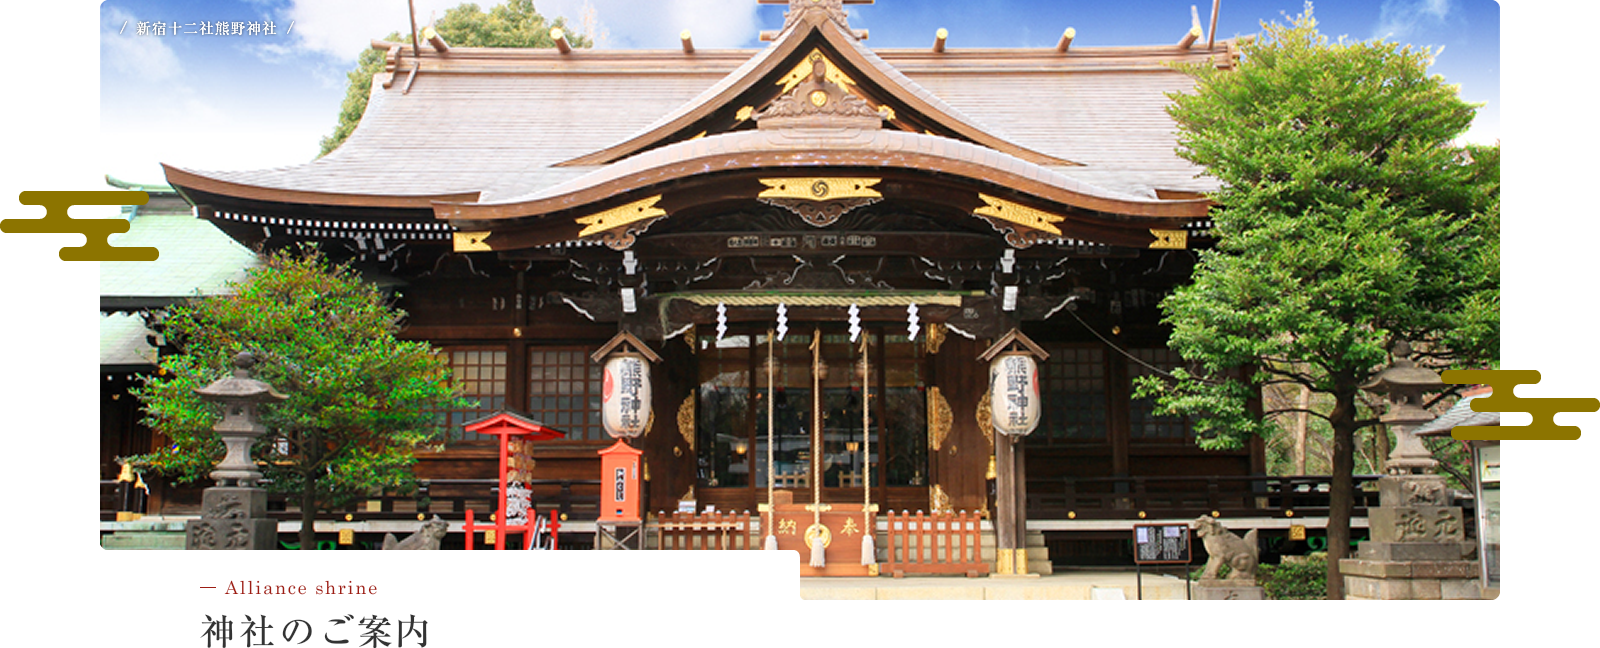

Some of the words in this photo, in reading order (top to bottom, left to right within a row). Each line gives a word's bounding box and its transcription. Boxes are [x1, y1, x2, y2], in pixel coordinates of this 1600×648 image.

[620, 358, 642, 429] 熊野神社
[1004, 356, 1028, 427] 熊野神社
